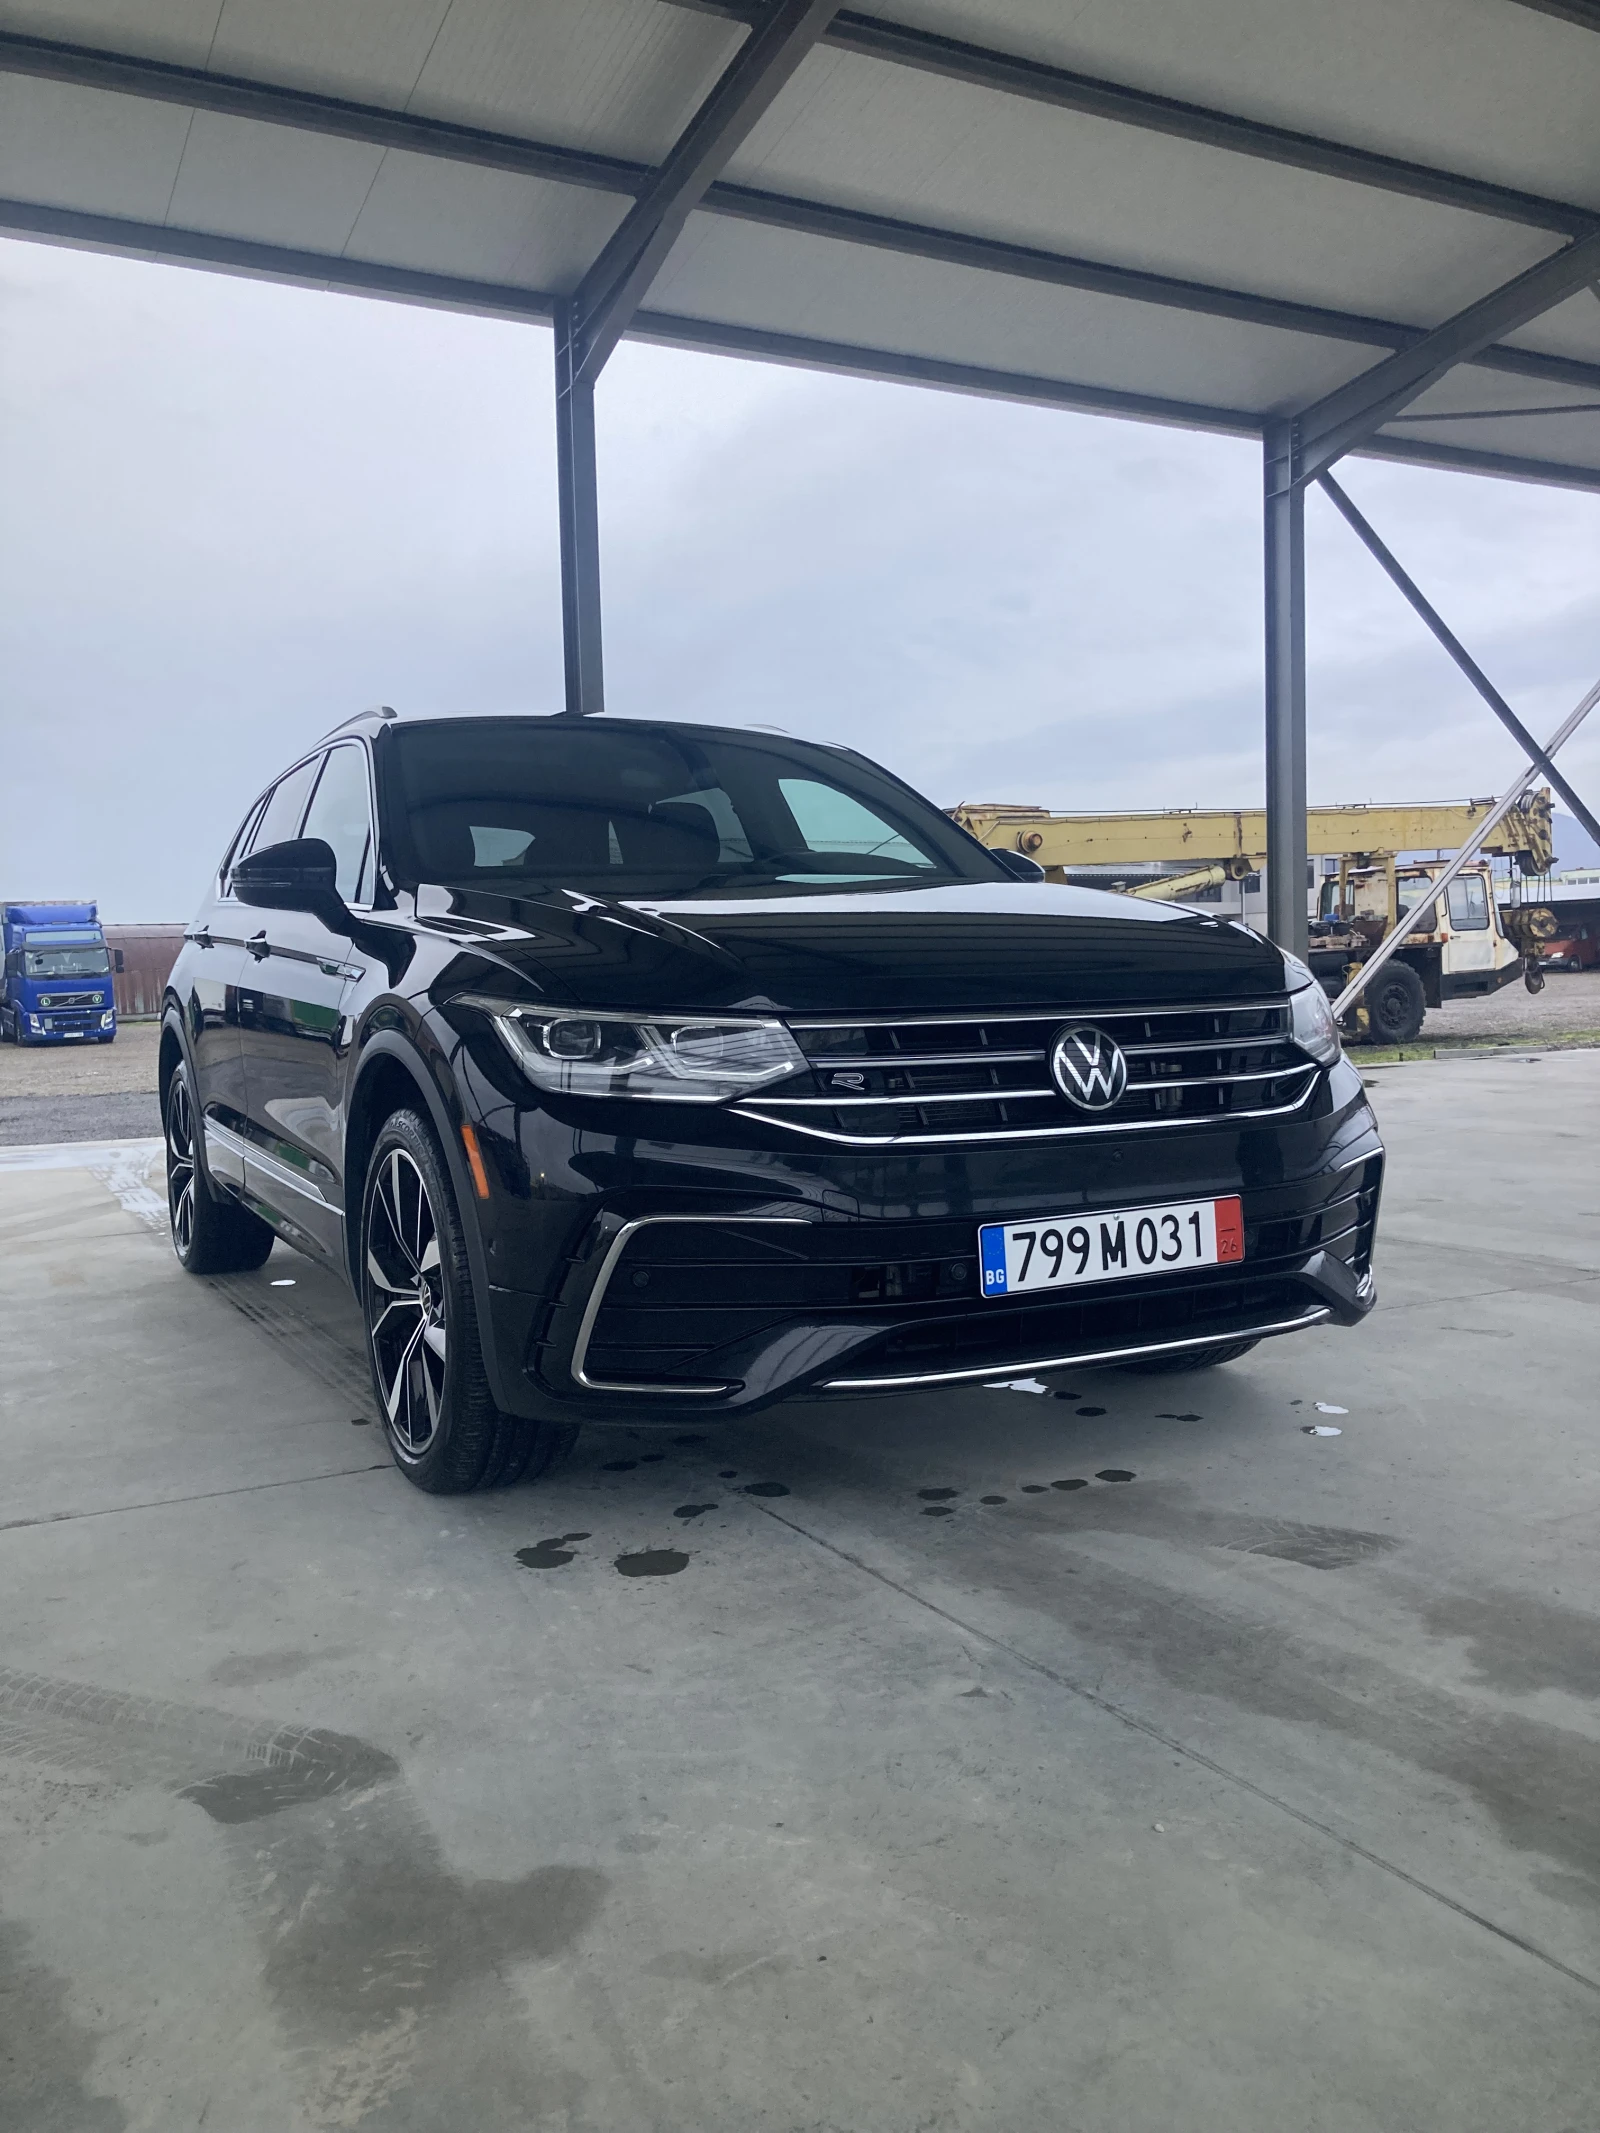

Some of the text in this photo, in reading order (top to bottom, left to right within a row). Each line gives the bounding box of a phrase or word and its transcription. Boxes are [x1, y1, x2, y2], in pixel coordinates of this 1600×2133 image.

[1055, 1027, 1124, 1104] VW
[831, 1072, 865, 1091] R
[1012, 1210, 1202, 1282] 799 M 031
[1220, 1237, 1238, 1254] 26
[985, 1268, 1005, 1286] BG
